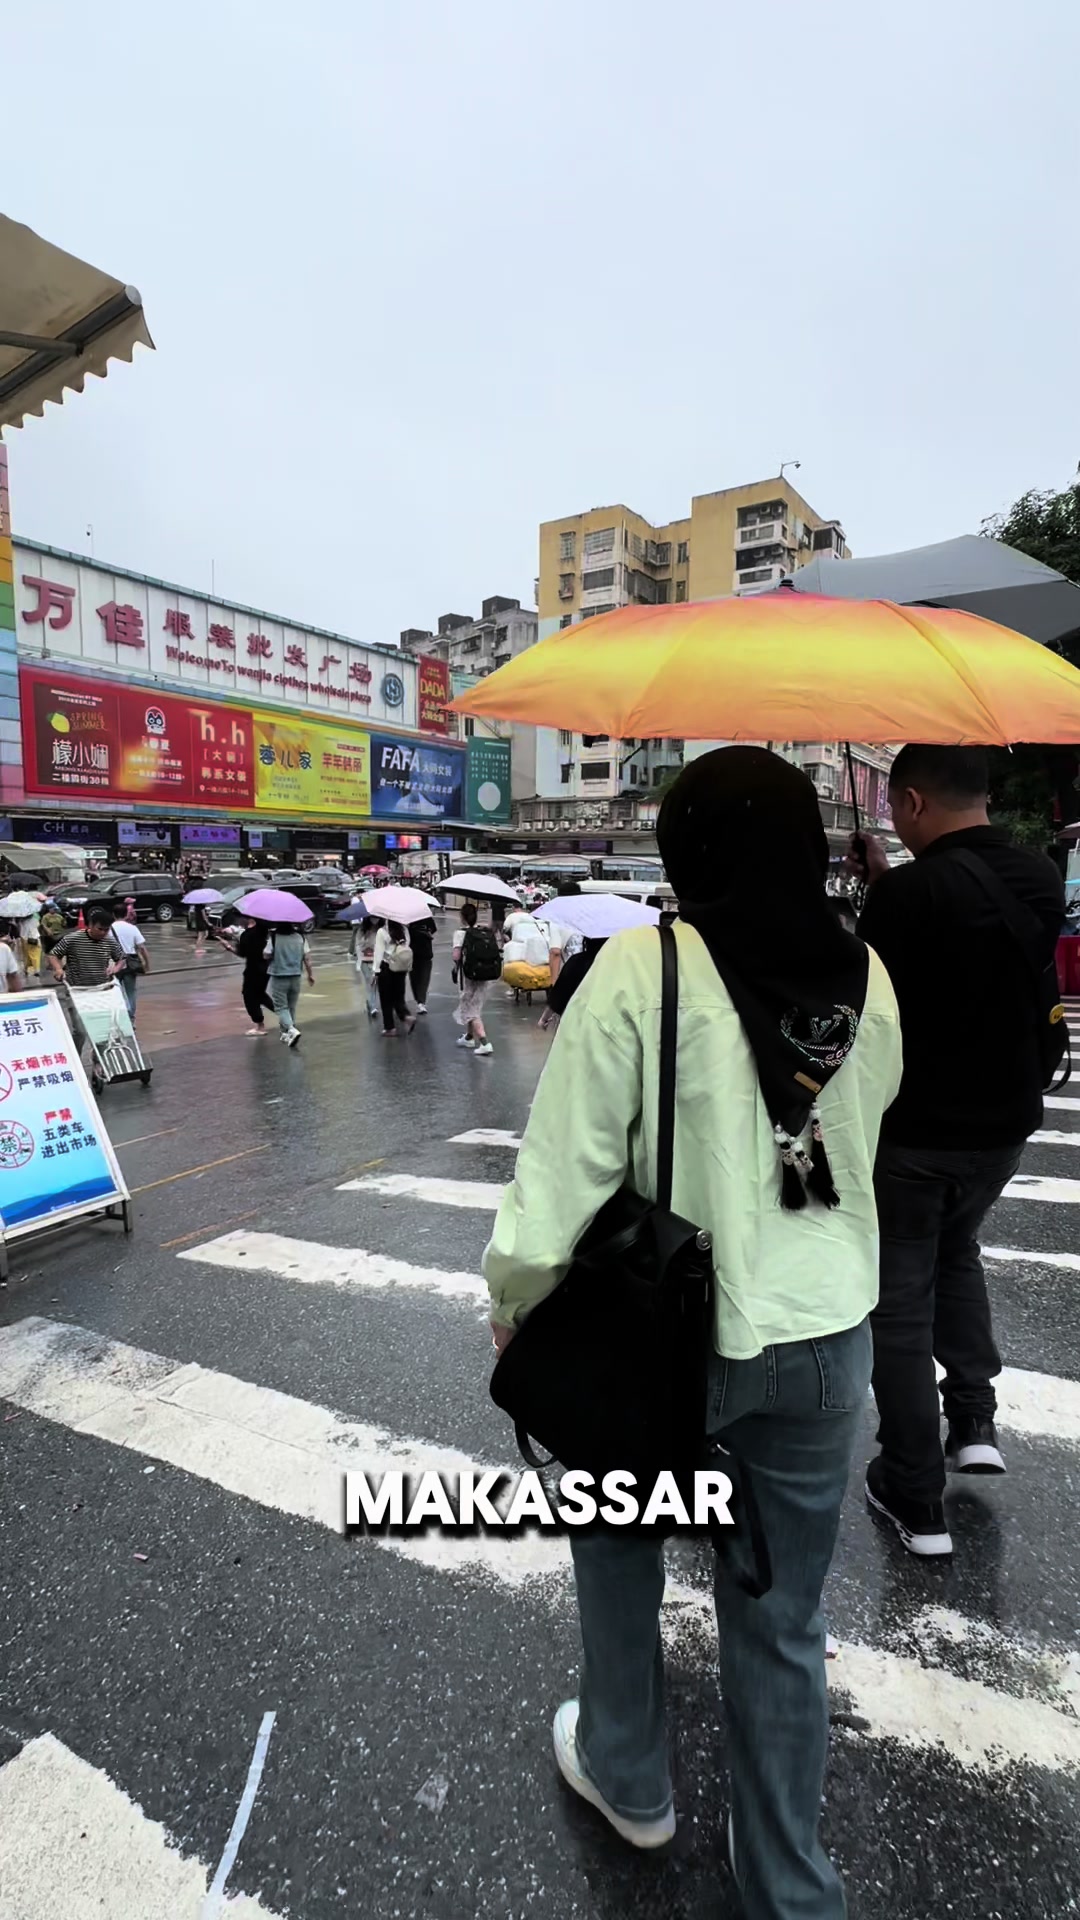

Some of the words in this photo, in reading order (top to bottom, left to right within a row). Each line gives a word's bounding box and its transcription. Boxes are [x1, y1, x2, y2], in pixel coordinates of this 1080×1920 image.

[22, 574, 372, 684] 万佳服装批发广场
[420, 678, 446, 700] DADA
[381, 746, 420, 773] FAFA
[11, 1052, 67, 1071] 无烟市场
[17, 1070, 74, 1091] 严禁吸烟
[44, 1107, 72, 1124] 严禁
[42, 1121, 84, 1141] 五类车
[0, 1135, 17, 1153] 禁
[40, 1134, 97, 1159] 进出市场
